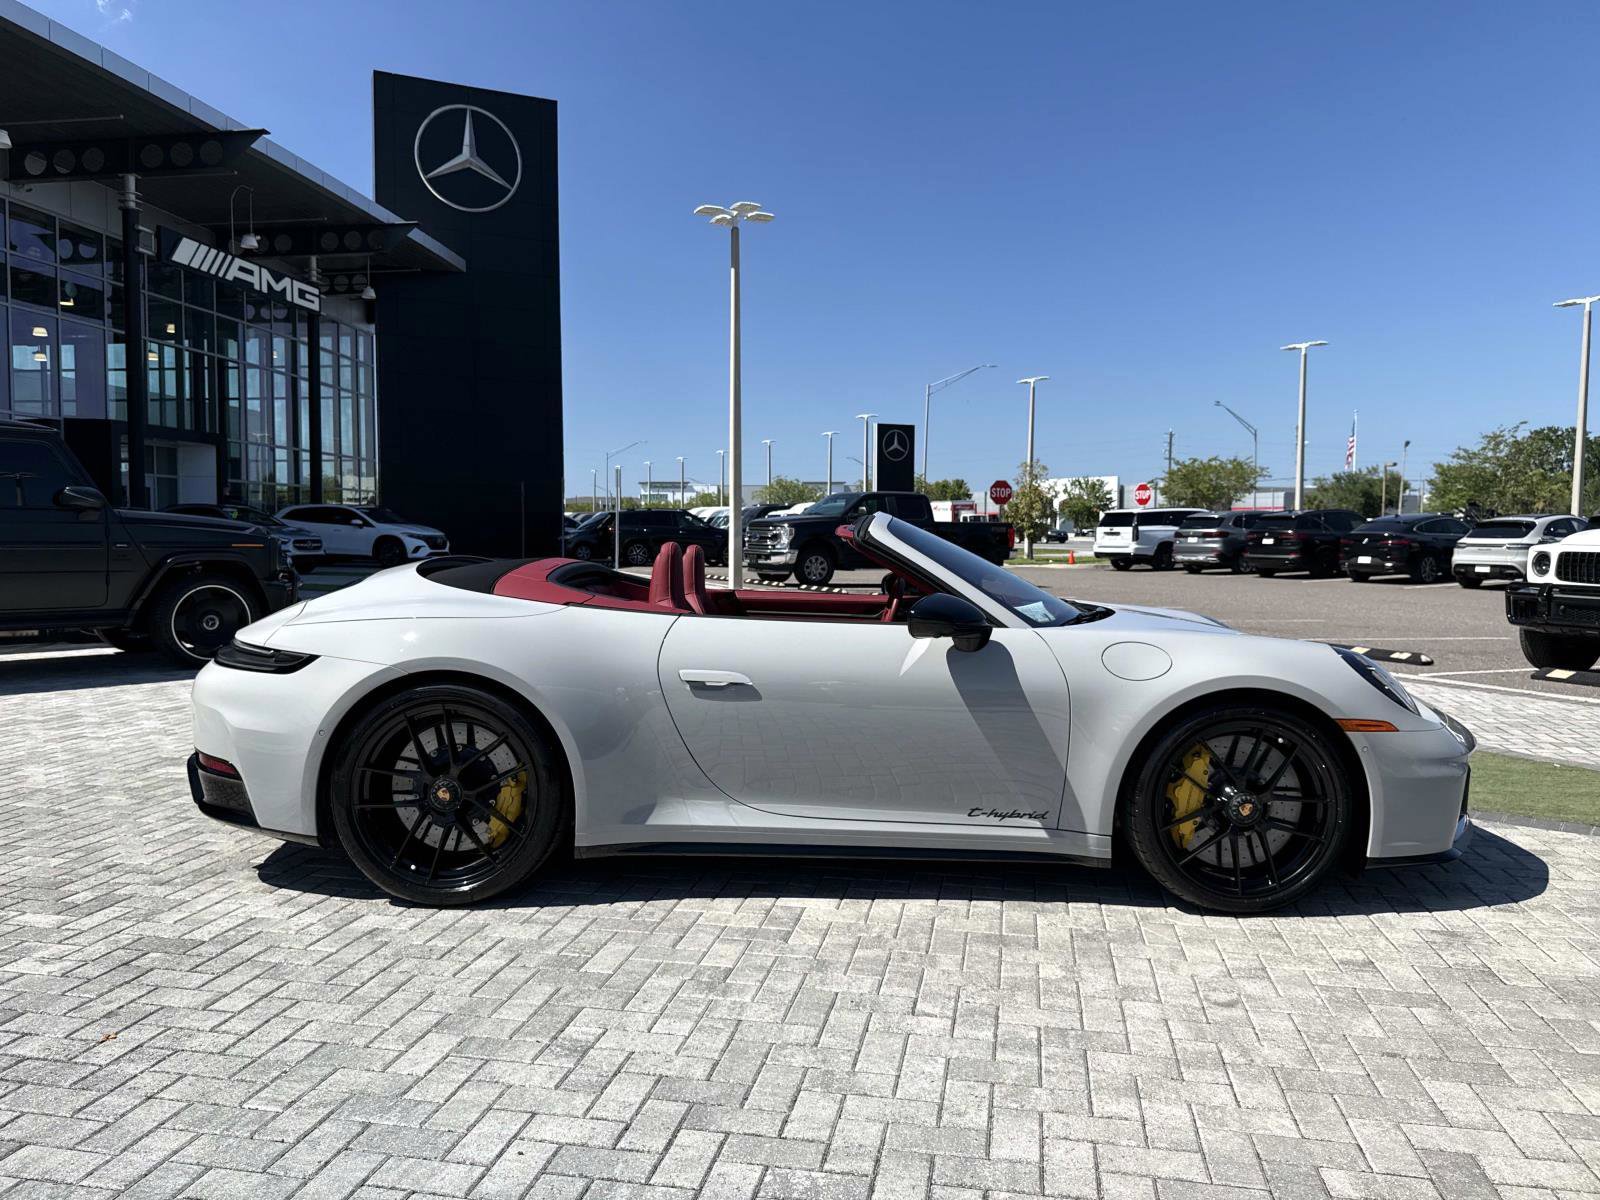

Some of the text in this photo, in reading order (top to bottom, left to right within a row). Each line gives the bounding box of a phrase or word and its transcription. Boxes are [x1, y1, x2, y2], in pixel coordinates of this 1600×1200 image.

[225, 257, 320, 312] AMG
[991, 487, 1011, 498] STOP
[1135, 490, 1150, 500] STOP
[967, 806, 1049, 822] t-hybrid
